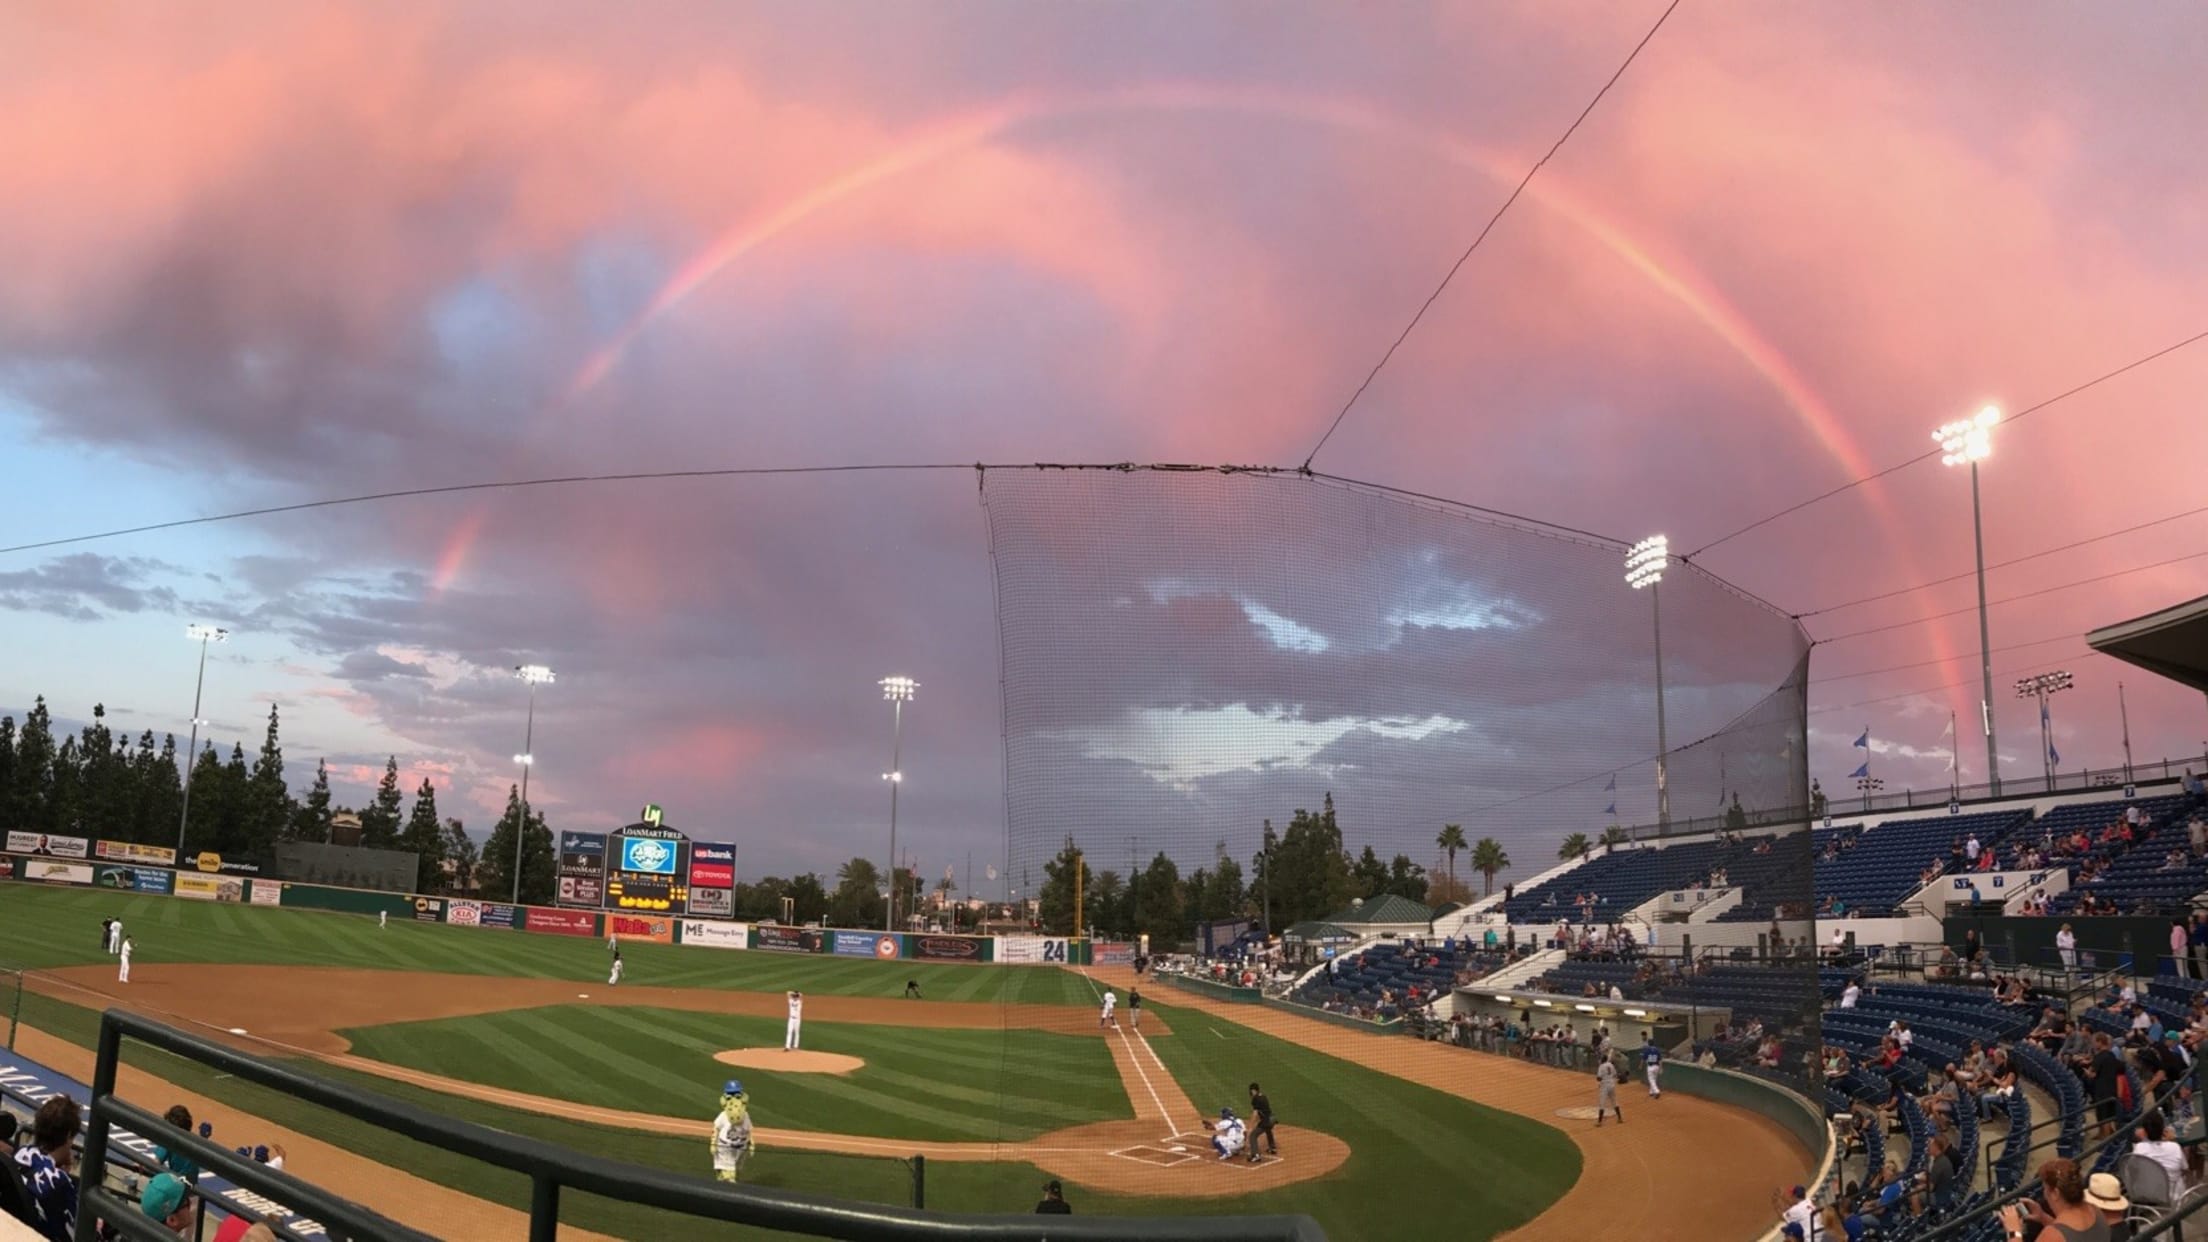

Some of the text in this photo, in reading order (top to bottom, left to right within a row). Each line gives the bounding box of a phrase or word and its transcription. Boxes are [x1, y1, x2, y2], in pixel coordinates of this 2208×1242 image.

[185, 856, 197, 864] the
[200, 858, 219, 867] smile
[220, 862, 259, 872] generation
[705, 871, 731, 880] TOYOTA
[455, 910, 473, 918] KIA
[613, 917, 651, 936] WaBa
[1043, 940, 1065, 962] 24
